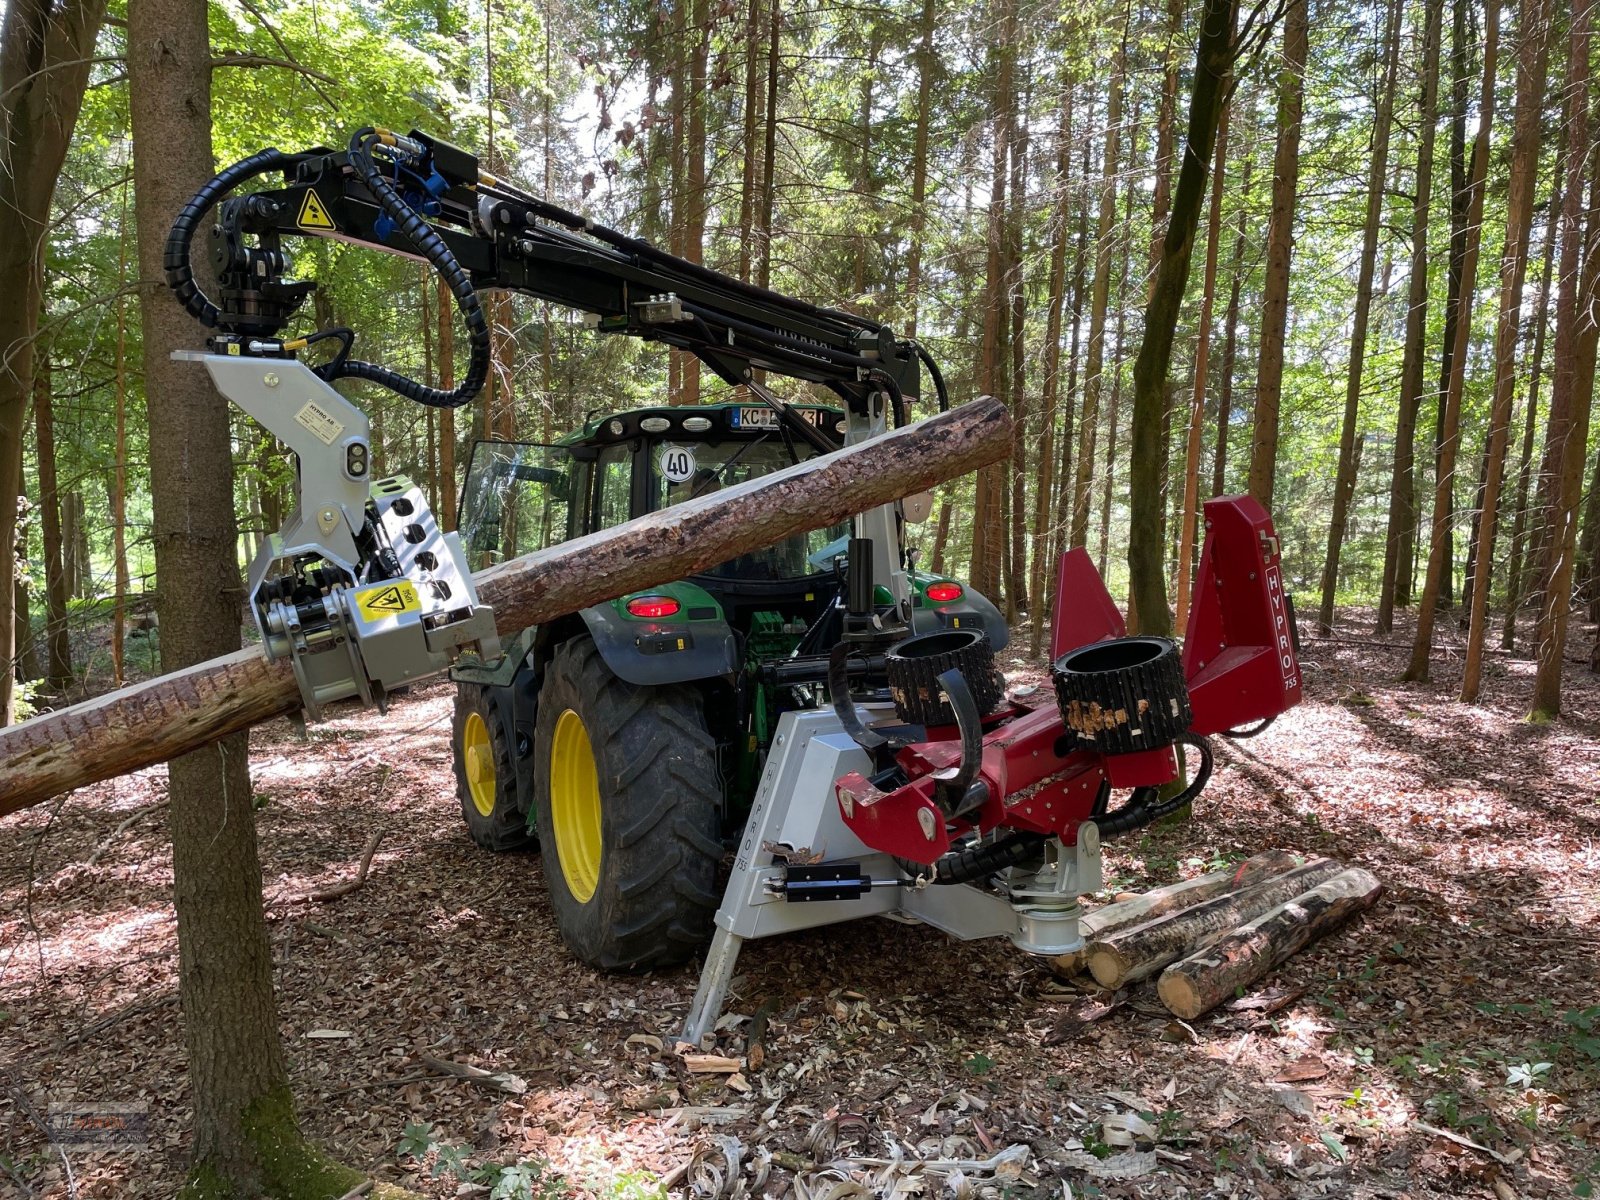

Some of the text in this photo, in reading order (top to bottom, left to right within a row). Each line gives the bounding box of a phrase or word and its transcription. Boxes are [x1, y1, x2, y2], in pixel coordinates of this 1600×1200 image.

[309, 404, 326, 420] HYPRO
[741, 409, 760, 425] KC
[667, 452, 689, 476] 40
[1269, 575, 1291, 669] HYPRO
[1284, 676, 1297, 691] 755
[744, 769, 773, 851] HYPRO
[736, 858, 748, 872] 755
